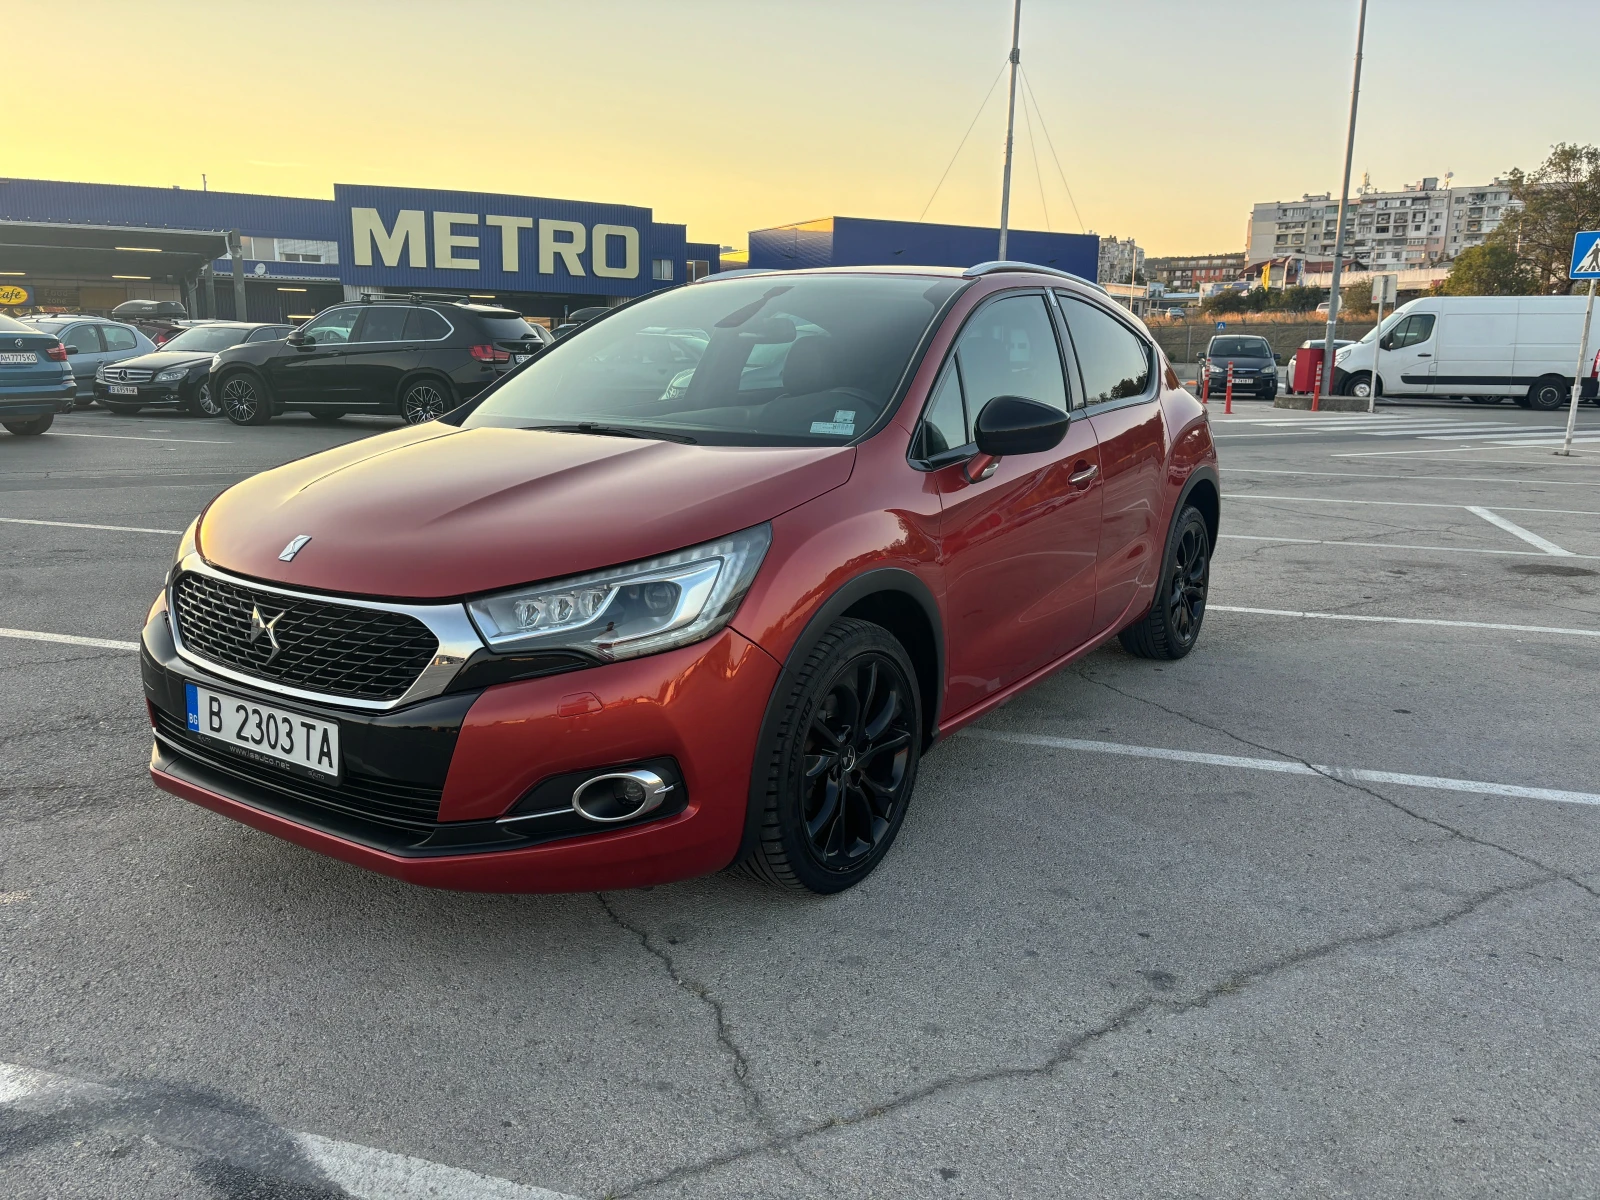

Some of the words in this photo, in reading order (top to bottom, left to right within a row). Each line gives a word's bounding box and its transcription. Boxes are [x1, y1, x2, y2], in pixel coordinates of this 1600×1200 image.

[351, 206, 640, 279] METRO
[188, 713, 198, 725] BG
[208, 695, 223, 733] B
[235, 704, 294, 755] 2303
[301, 720, 334, 769] TA
